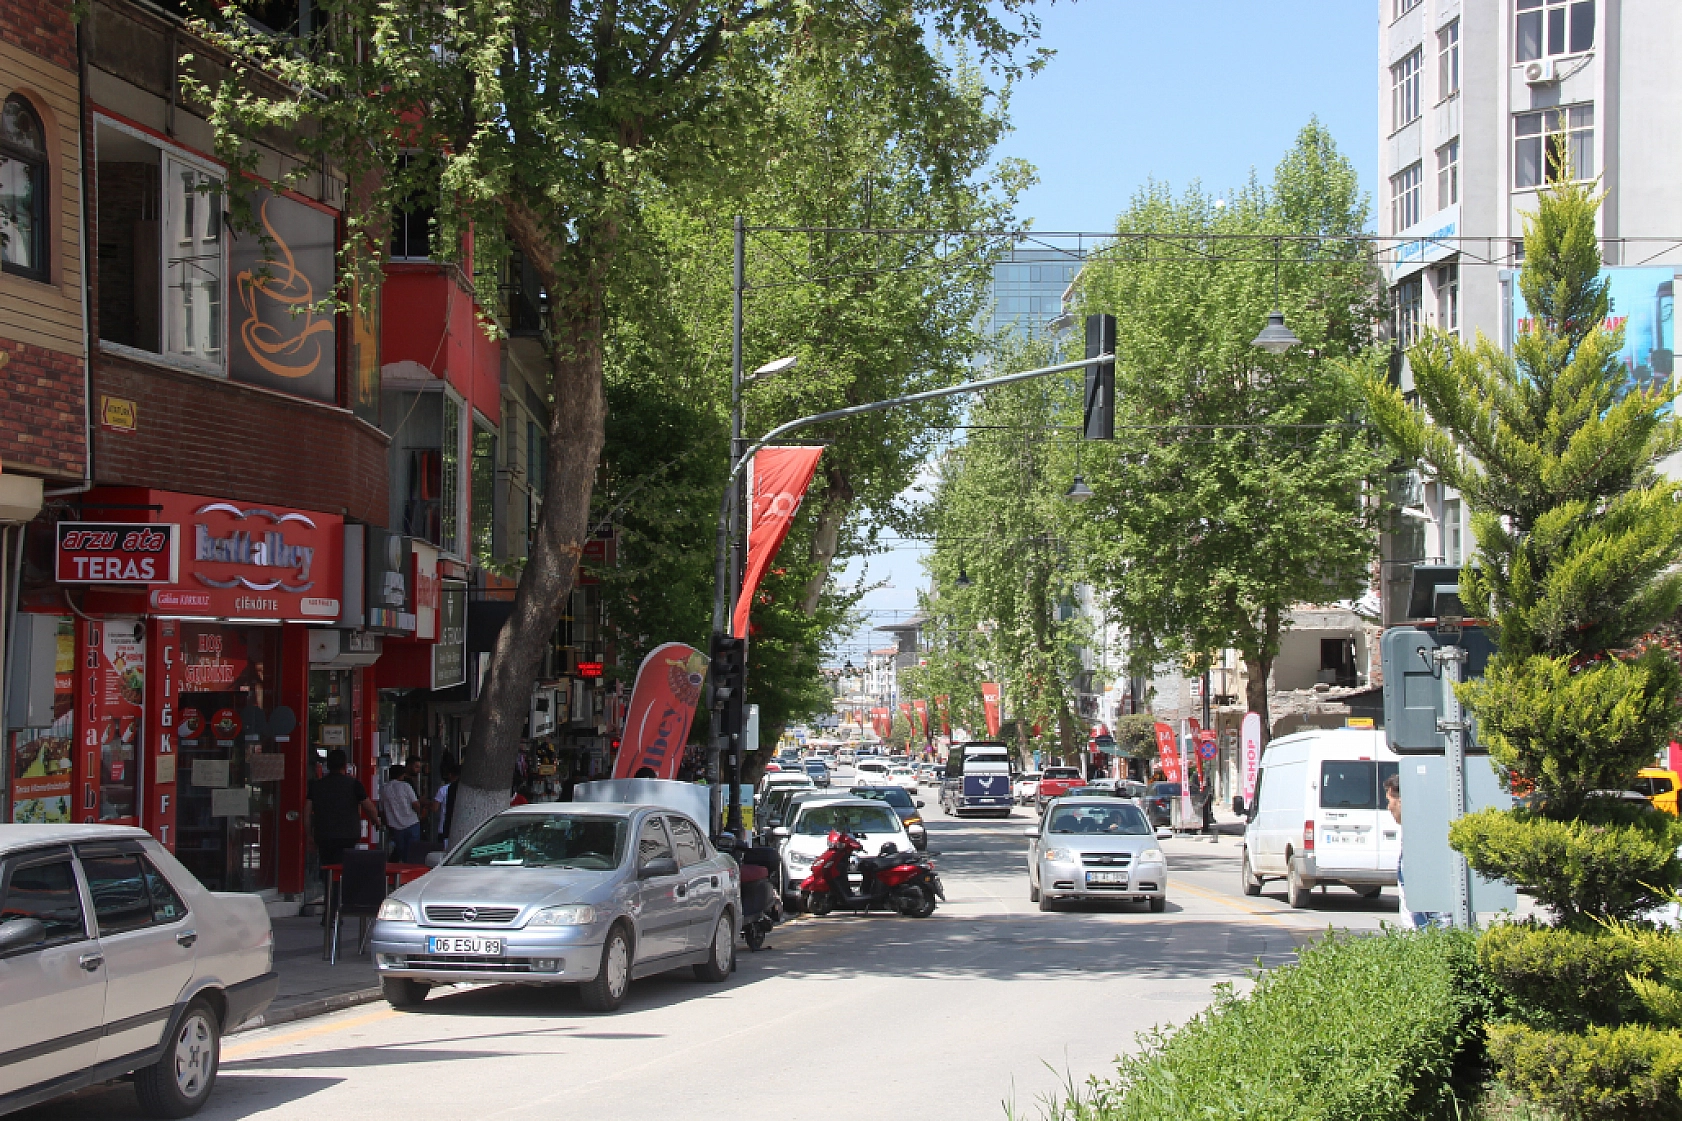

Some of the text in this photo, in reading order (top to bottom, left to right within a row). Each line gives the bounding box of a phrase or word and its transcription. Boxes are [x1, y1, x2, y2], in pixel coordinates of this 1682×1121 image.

[62, 528, 165, 551] arzu ata
[73, 556, 156, 580] TERAS
[159, 646, 173, 843] ÇİĞKFT
[435, 938, 450, 953] 06
[455, 938, 481, 954] ESU
